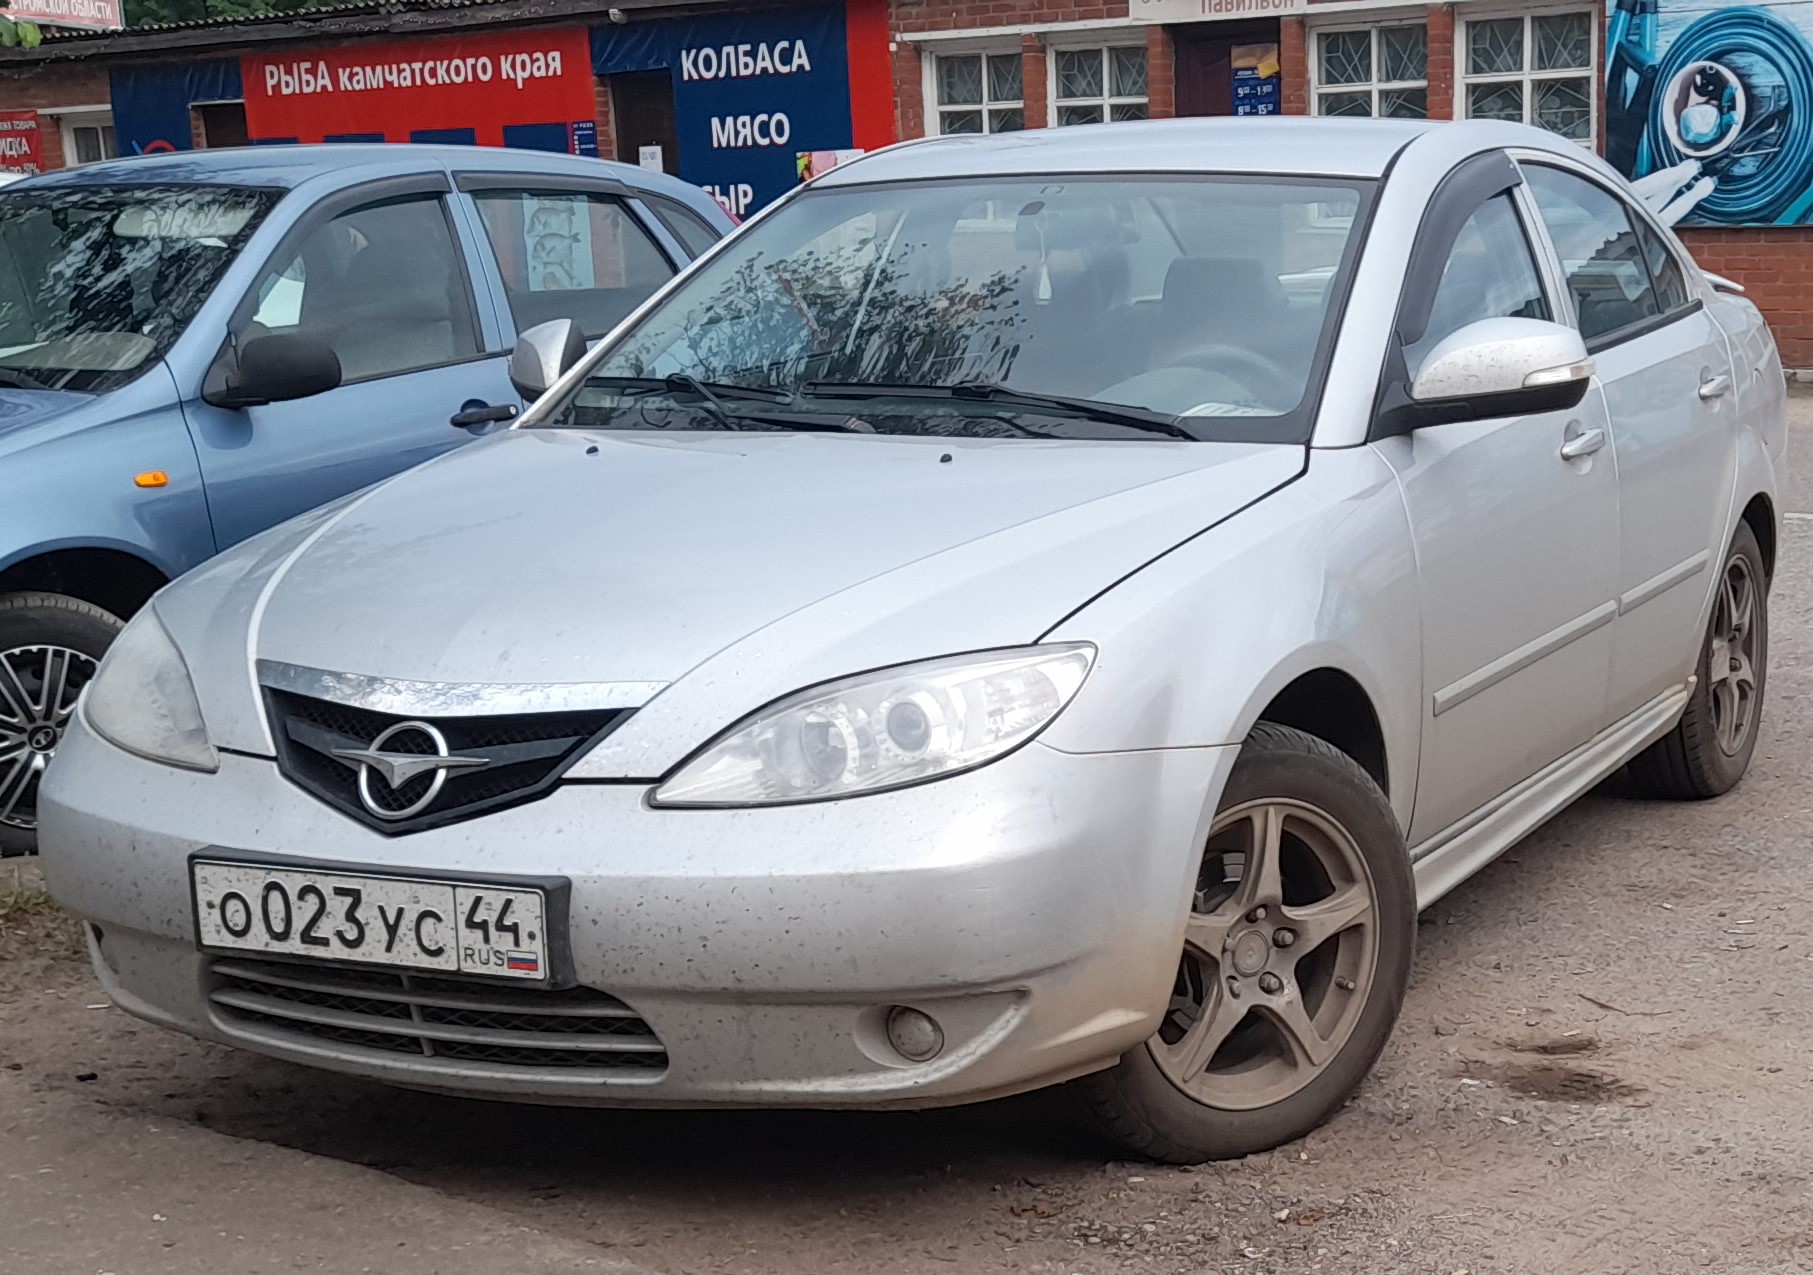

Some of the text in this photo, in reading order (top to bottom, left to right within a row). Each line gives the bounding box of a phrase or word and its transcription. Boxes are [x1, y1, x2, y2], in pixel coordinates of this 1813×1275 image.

[71, 0, 112, 19] ОБЛАСТИ
[265, 50, 562, 96] РЫБА камчатского края
[681, 40, 811, 81] КОЛБАСА
[710, 112, 790, 148] МЯСО
[464, 895, 520, 947] 44
[463, 946, 505, 967] RUS
